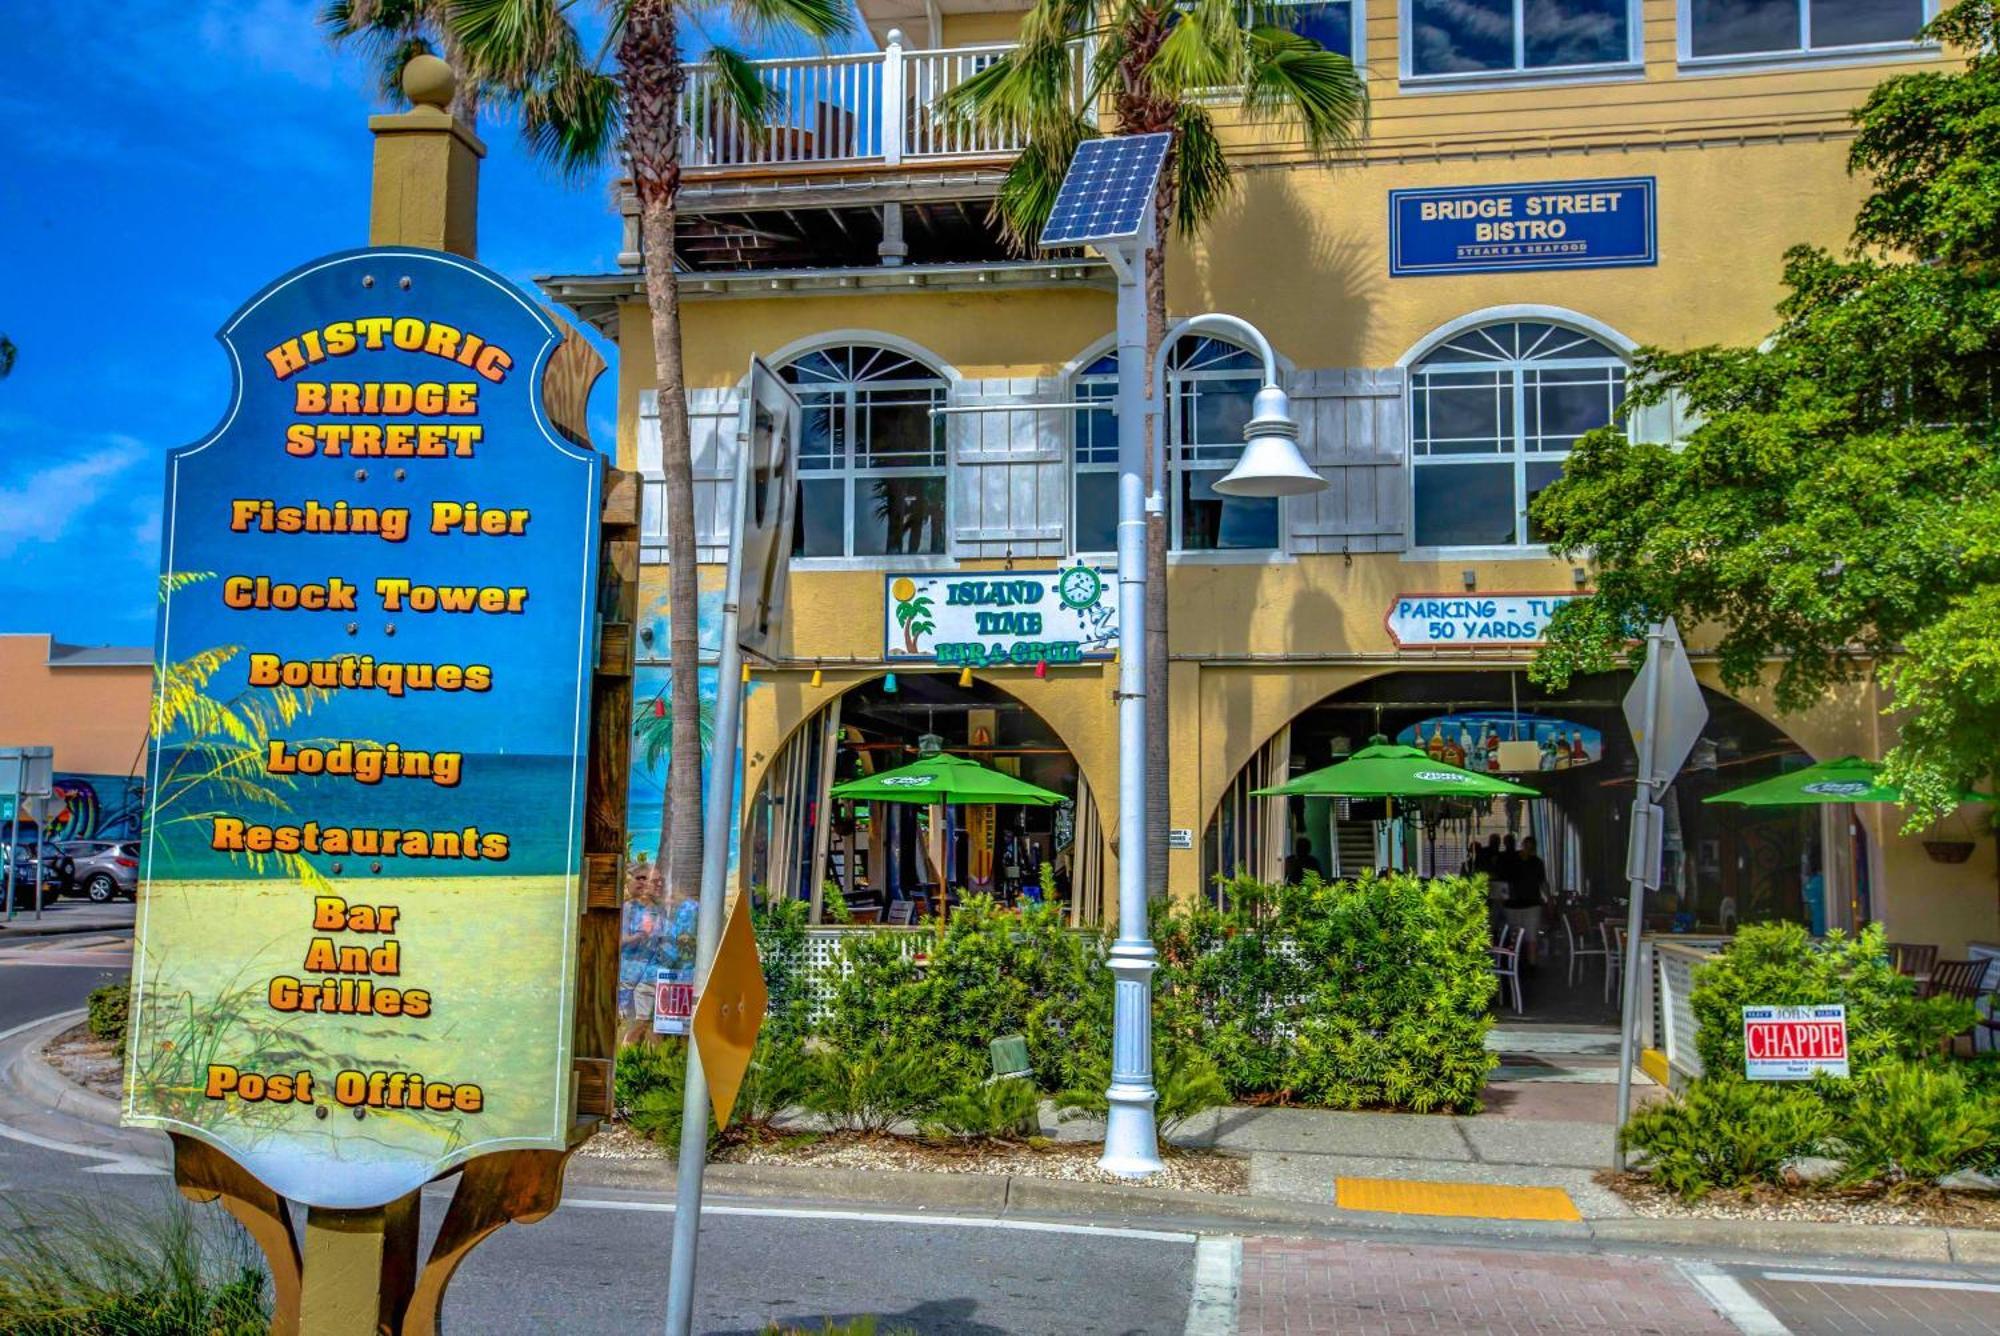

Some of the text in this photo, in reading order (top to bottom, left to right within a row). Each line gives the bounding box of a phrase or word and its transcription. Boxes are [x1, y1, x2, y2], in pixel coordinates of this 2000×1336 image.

[1421, 192, 1622, 221] BRIDGE STREET
[1476, 219, 1567, 242] BISTRO
[1457, 243, 1588, 257] STEAKS & SEAFOOD
[264, 317, 514, 383] HISTORIC
[295, 382, 478, 416] BRIDGE
[285, 424, 483, 457] STREET
[230, 499, 530, 541] Fishing Pier
[223, 576, 529, 613] Clock Tower
[946, 580, 1044, 607] ISLAND
[1400, 600, 1497, 619] PARKING
[1527, 600, 1567, 618] TU
[975, 612, 1042, 636] TIME
[1429, 621, 1537, 639] 50 YARDS
[934, 641, 1083, 665] BAR & GRILL
[249, 653, 493, 697] Boutiques
[267, 740, 463, 786] Lodging
[212, 817, 510, 861] Restaurants
[312, 896, 400, 934] Bar
[304, 937, 401, 976] And
[268, 976, 431, 1018] Grilles
[659, 985, 692, 1014] CHA
[1748, 1024, 1842, 1057] CHAPPIE
[205, 1064, 484, 1113] Post Office
